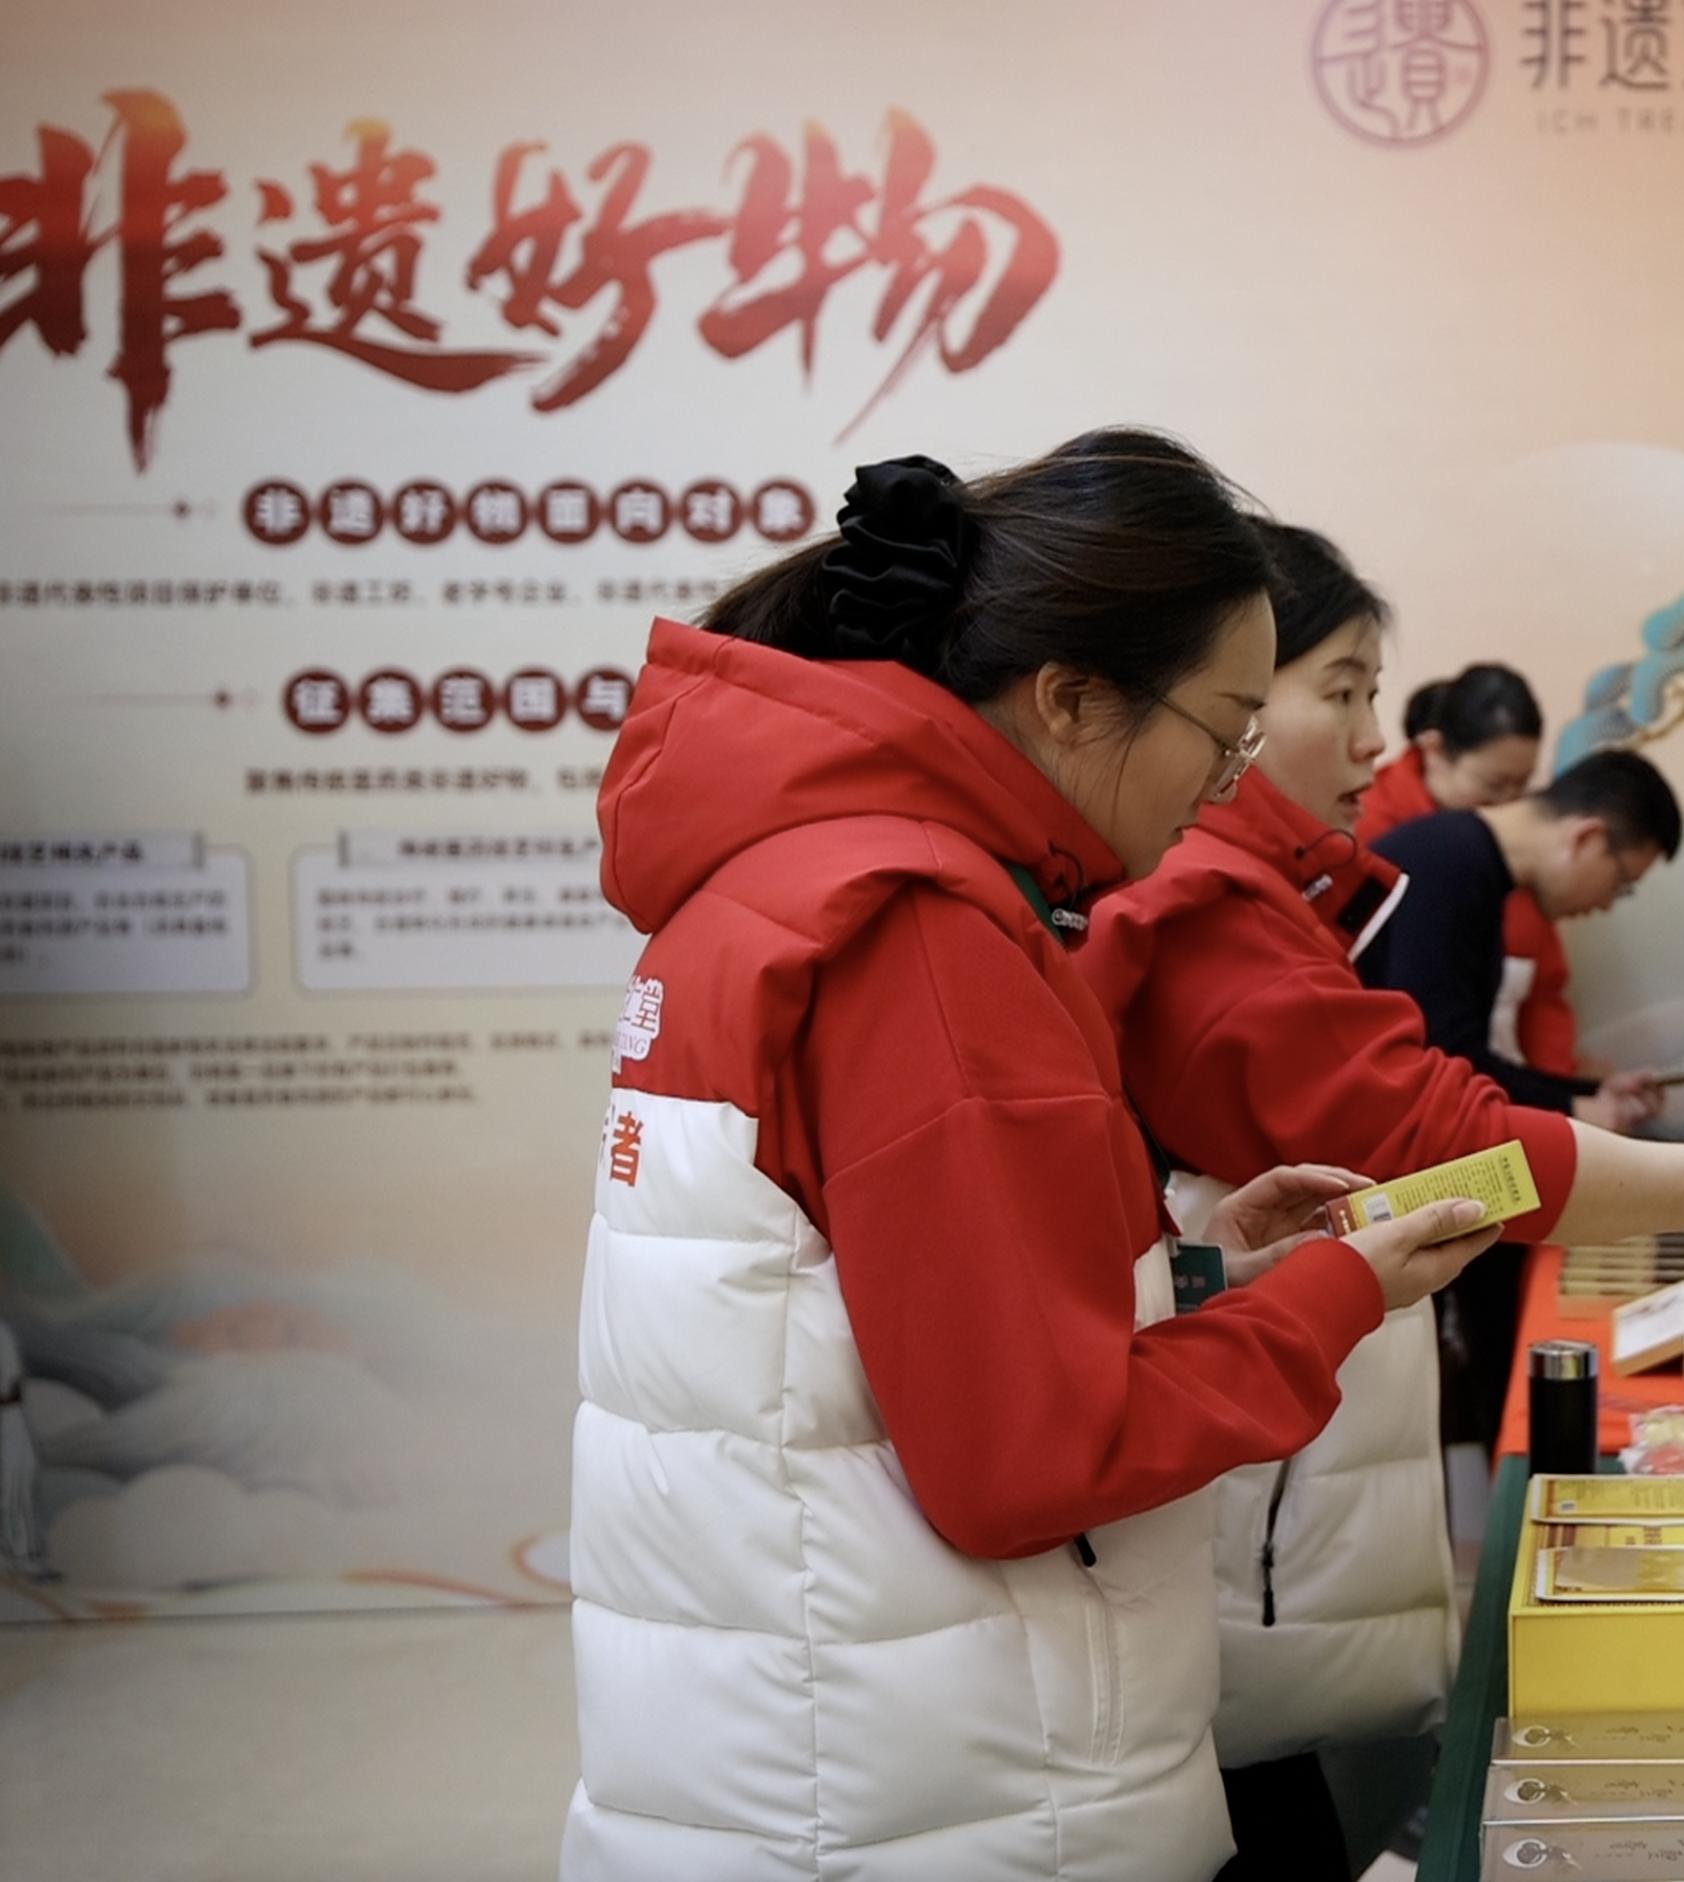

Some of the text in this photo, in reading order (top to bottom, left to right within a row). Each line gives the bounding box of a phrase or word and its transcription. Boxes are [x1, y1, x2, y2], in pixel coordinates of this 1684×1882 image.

[1536, 106, 1597, 134] ICH
[0, 88, 1061, 473] 非遗好物
[290, 675, 630, 726] 征集范围与
